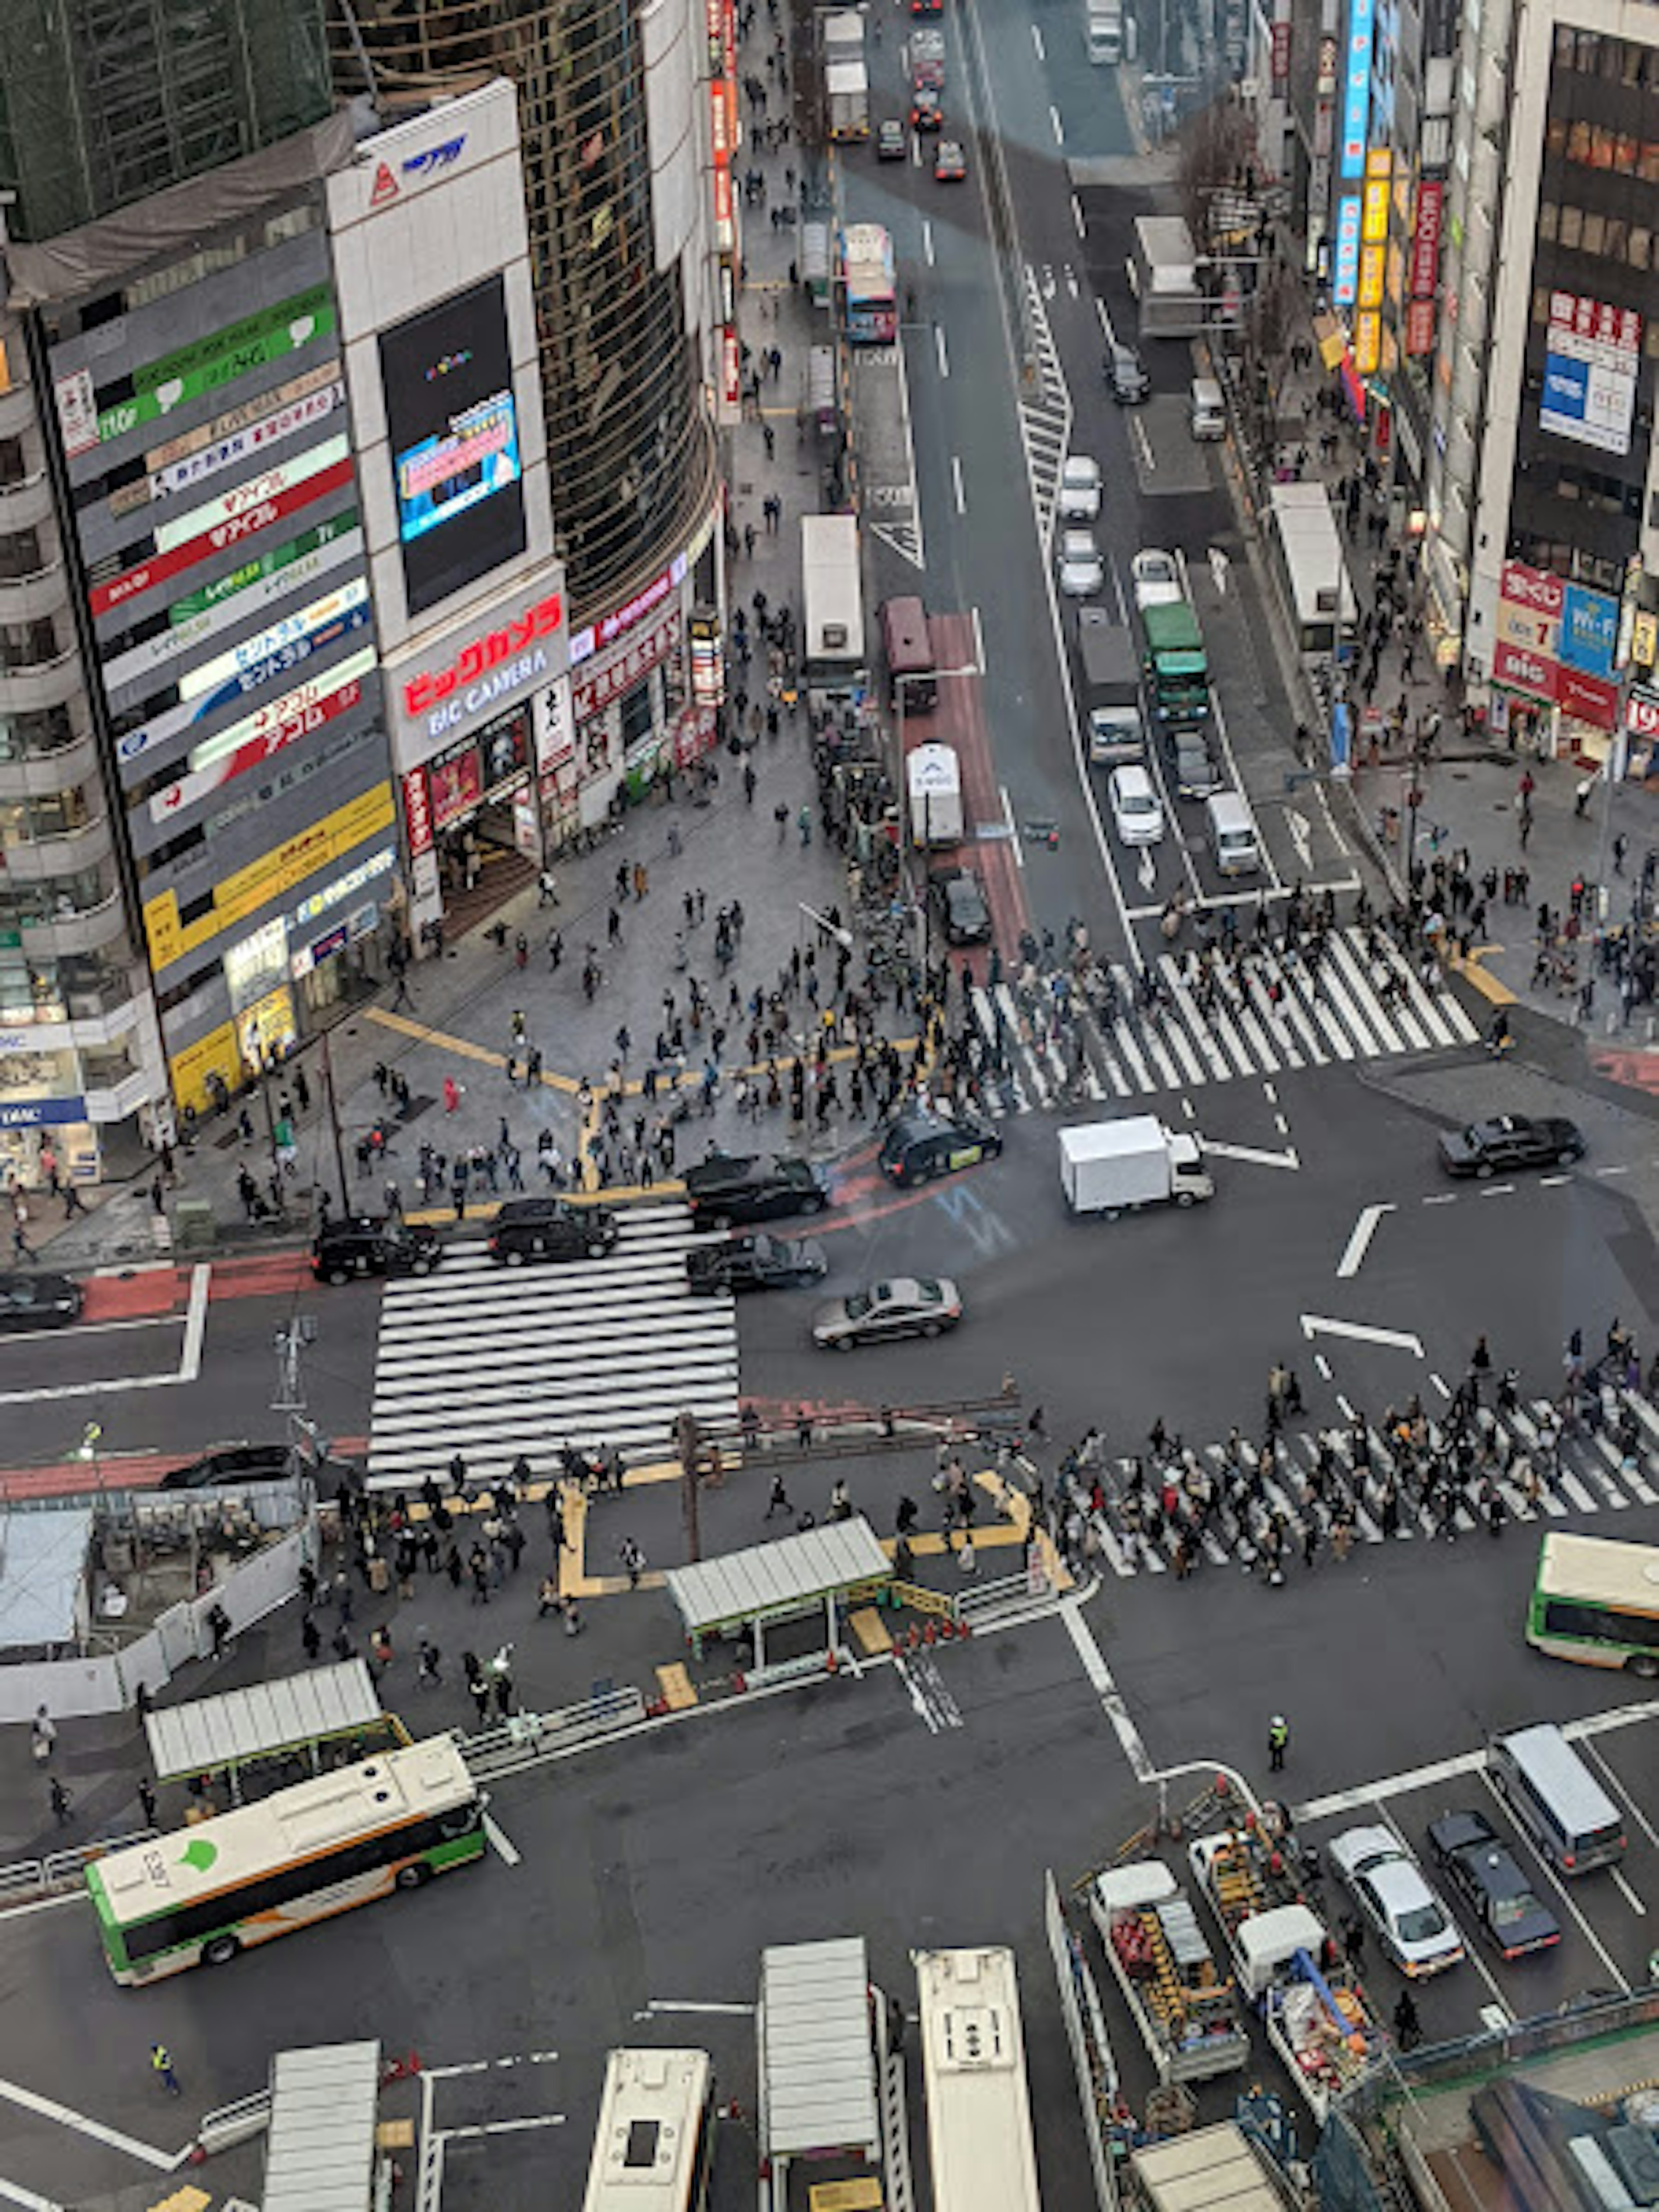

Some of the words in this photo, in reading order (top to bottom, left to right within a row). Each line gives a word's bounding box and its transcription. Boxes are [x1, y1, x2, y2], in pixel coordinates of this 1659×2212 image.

[239, 640, 312, 690] セントラル
[404, 594, 562, 716] ビックカメラ
[429, 703, 463, 737] BIC
[467, 649, 548, 712] CAMERA
[265, 703, 325, 756] アコム
